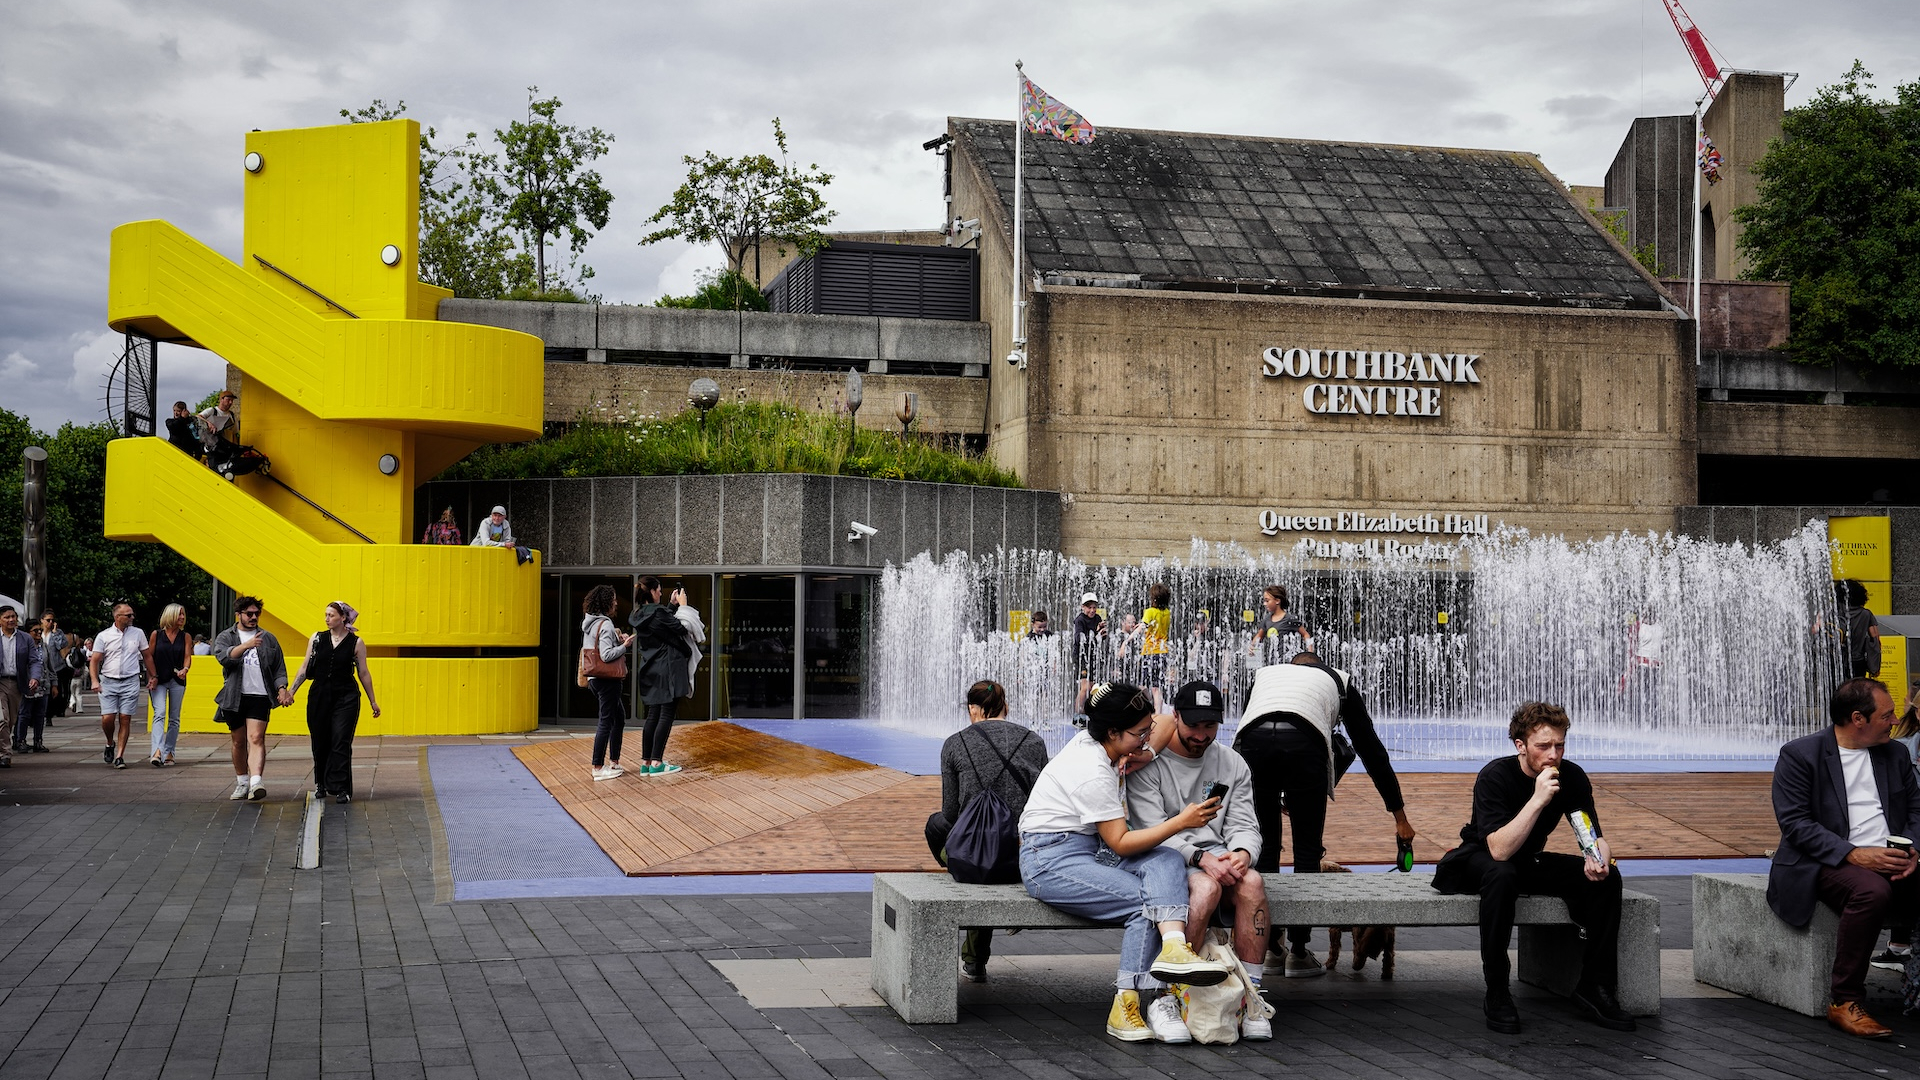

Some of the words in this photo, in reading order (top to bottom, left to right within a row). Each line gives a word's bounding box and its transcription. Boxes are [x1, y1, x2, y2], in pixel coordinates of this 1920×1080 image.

[1262, 347, 1481, 383] SOUTHBANK
[1303, 383, 1441, 417] CENTRE
[1258, 510, 1332, 535] Queen
[1336, 511, 1440, 534] Elizabeth
[1443, 514, 1488, 534] Hall
[1300, 537, 1379, 558] Purell
